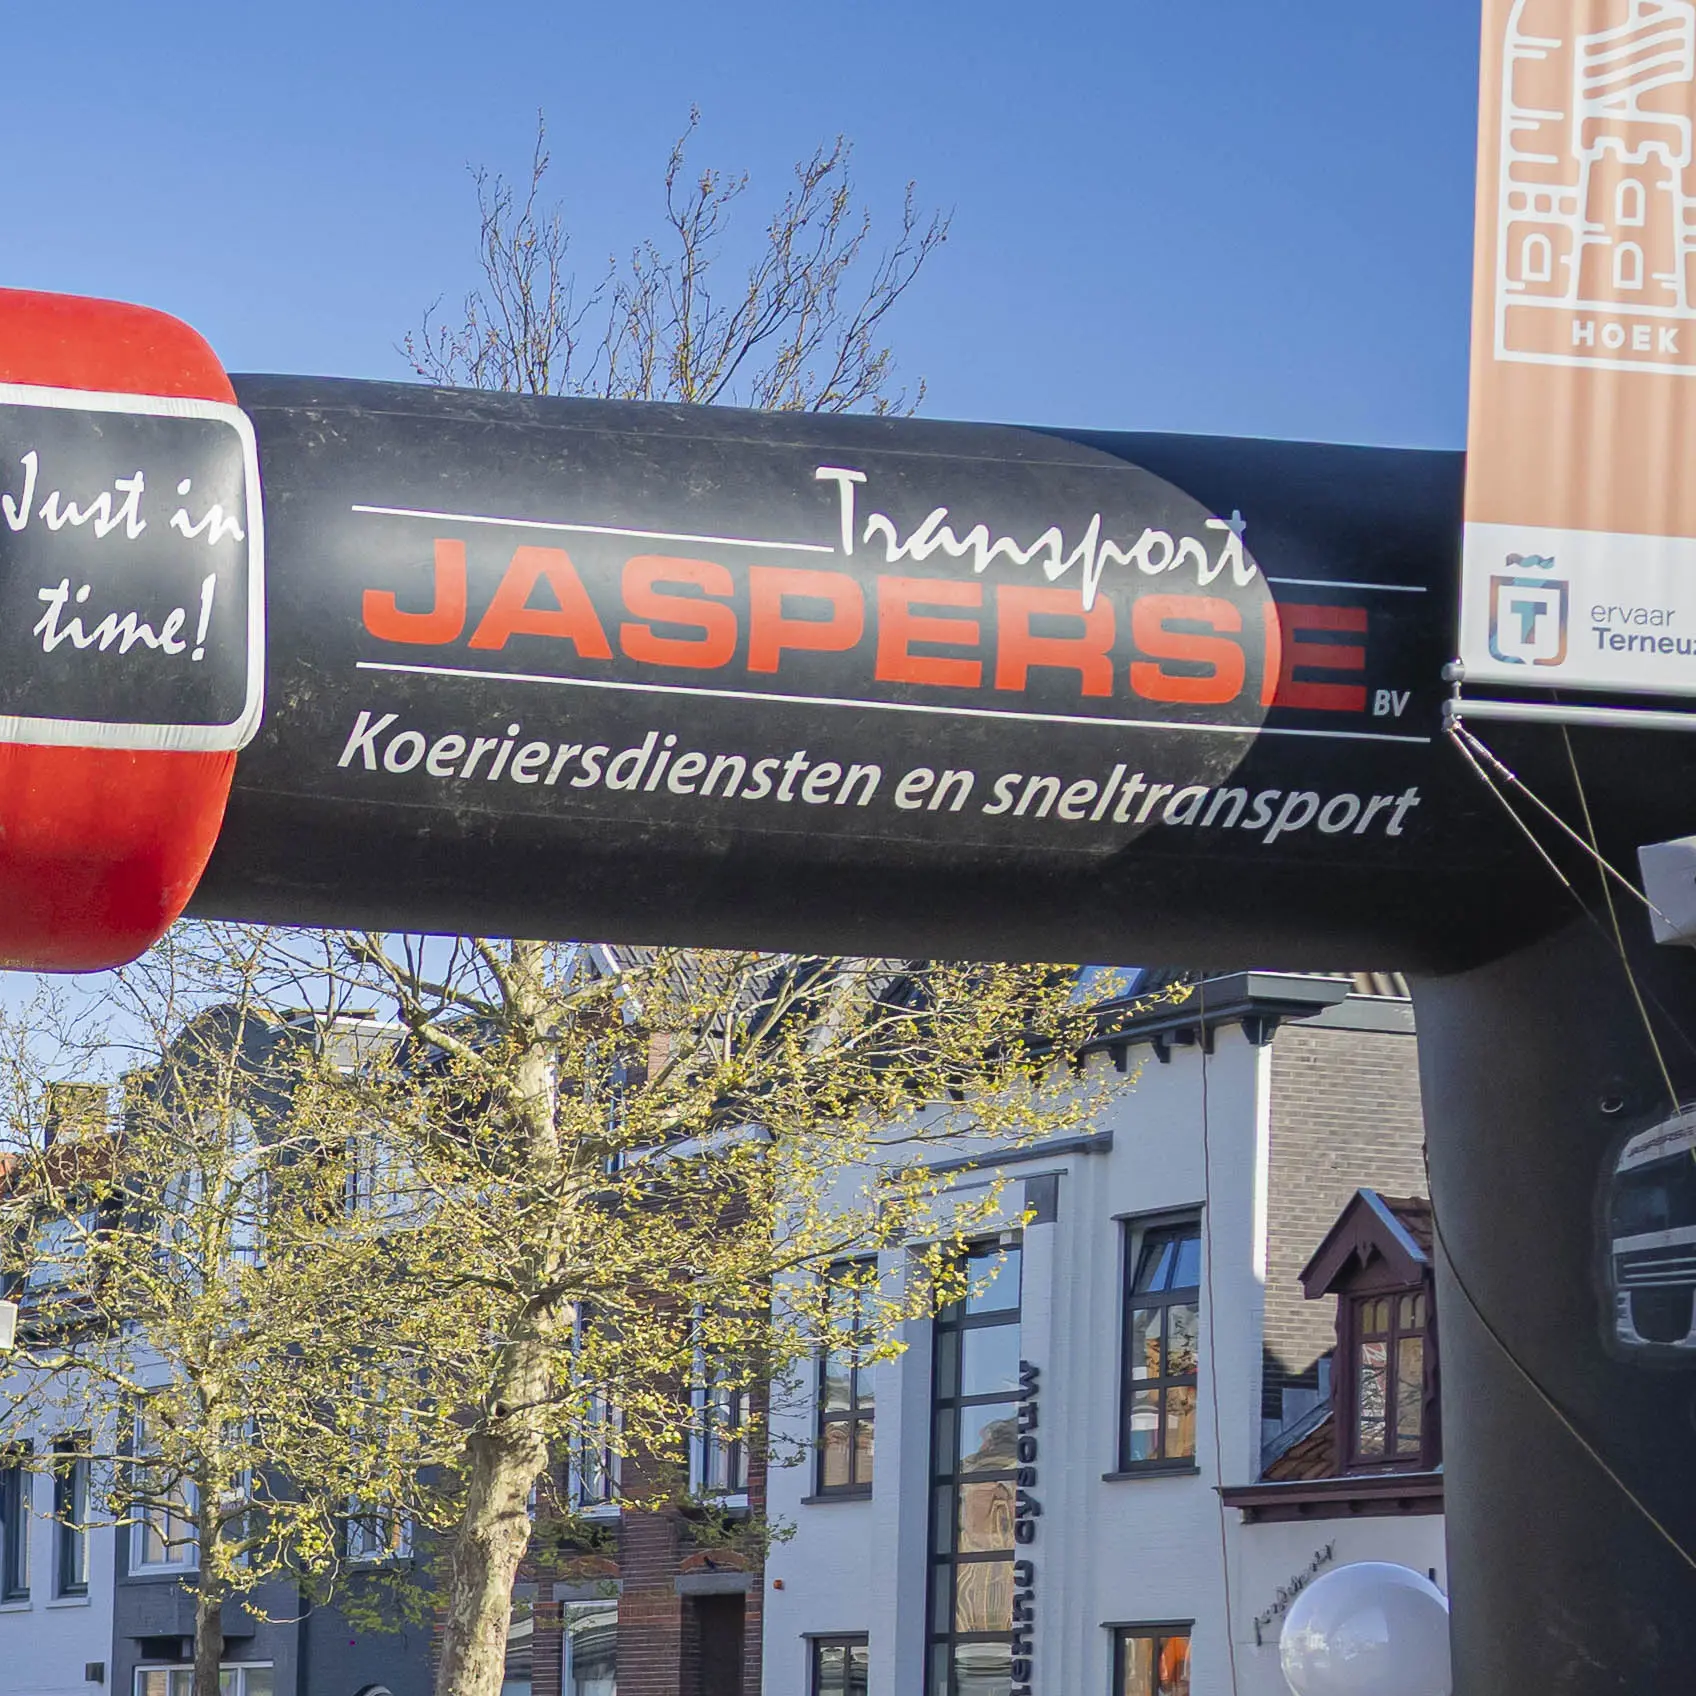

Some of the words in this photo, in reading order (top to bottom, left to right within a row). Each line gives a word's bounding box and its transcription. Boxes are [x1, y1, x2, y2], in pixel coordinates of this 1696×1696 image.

[1572, 320, 1681, 355] HOEK
[0, 450, 147, 540] Just
[169, 477, 246, 544] in
[816, 465, 1257, 612] Transport
[32, 572, 217, 662] time!
[362, 538, 1369, 713] JASPERSE
[1372, 689, 1411, 719] BV
[1591, 602, 1675, 626] ervaar
[337, 709, 883, 807] Koeriersdiensten
[894, 765, 976, 813] en
[981, 764, 1421, 845] sneltransport
